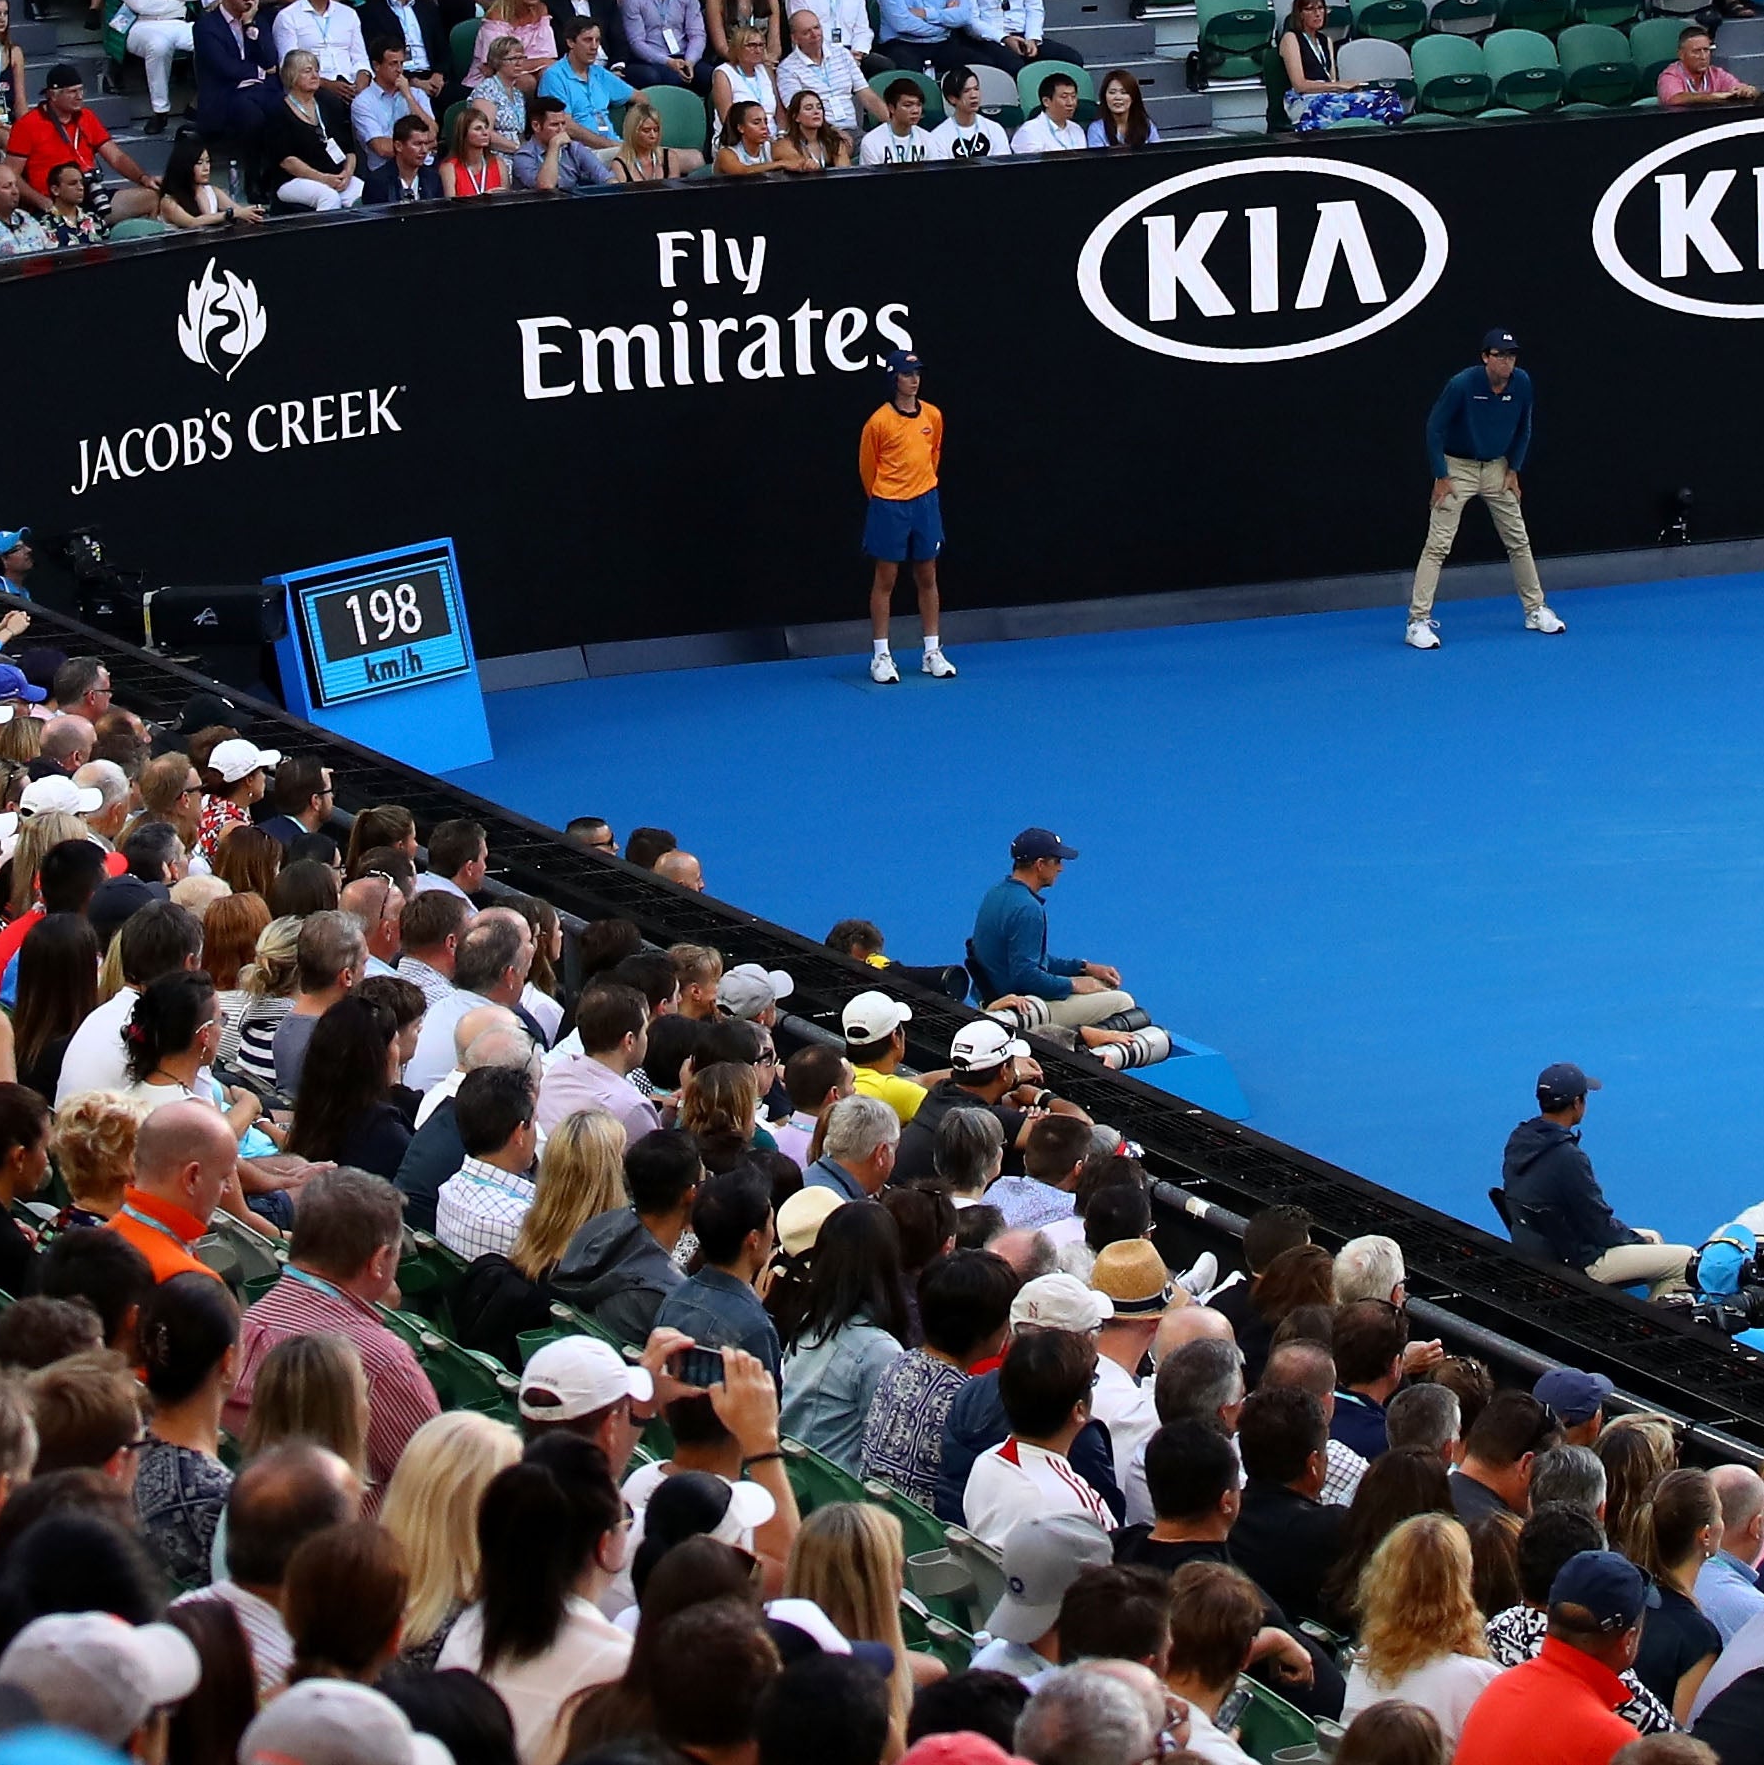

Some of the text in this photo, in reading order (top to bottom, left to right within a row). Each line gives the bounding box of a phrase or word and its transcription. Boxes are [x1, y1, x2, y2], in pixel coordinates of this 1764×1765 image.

[656, 229, 766, 294] Fly
[1143, 201, 1387, 322] KIA
[516, 298, 913, 399] Emirates
[71, 386, 402, 496] JACOB'S CREEK
[345, 583, 423, 646] 198
[363, 646, 423, 684] km/h
